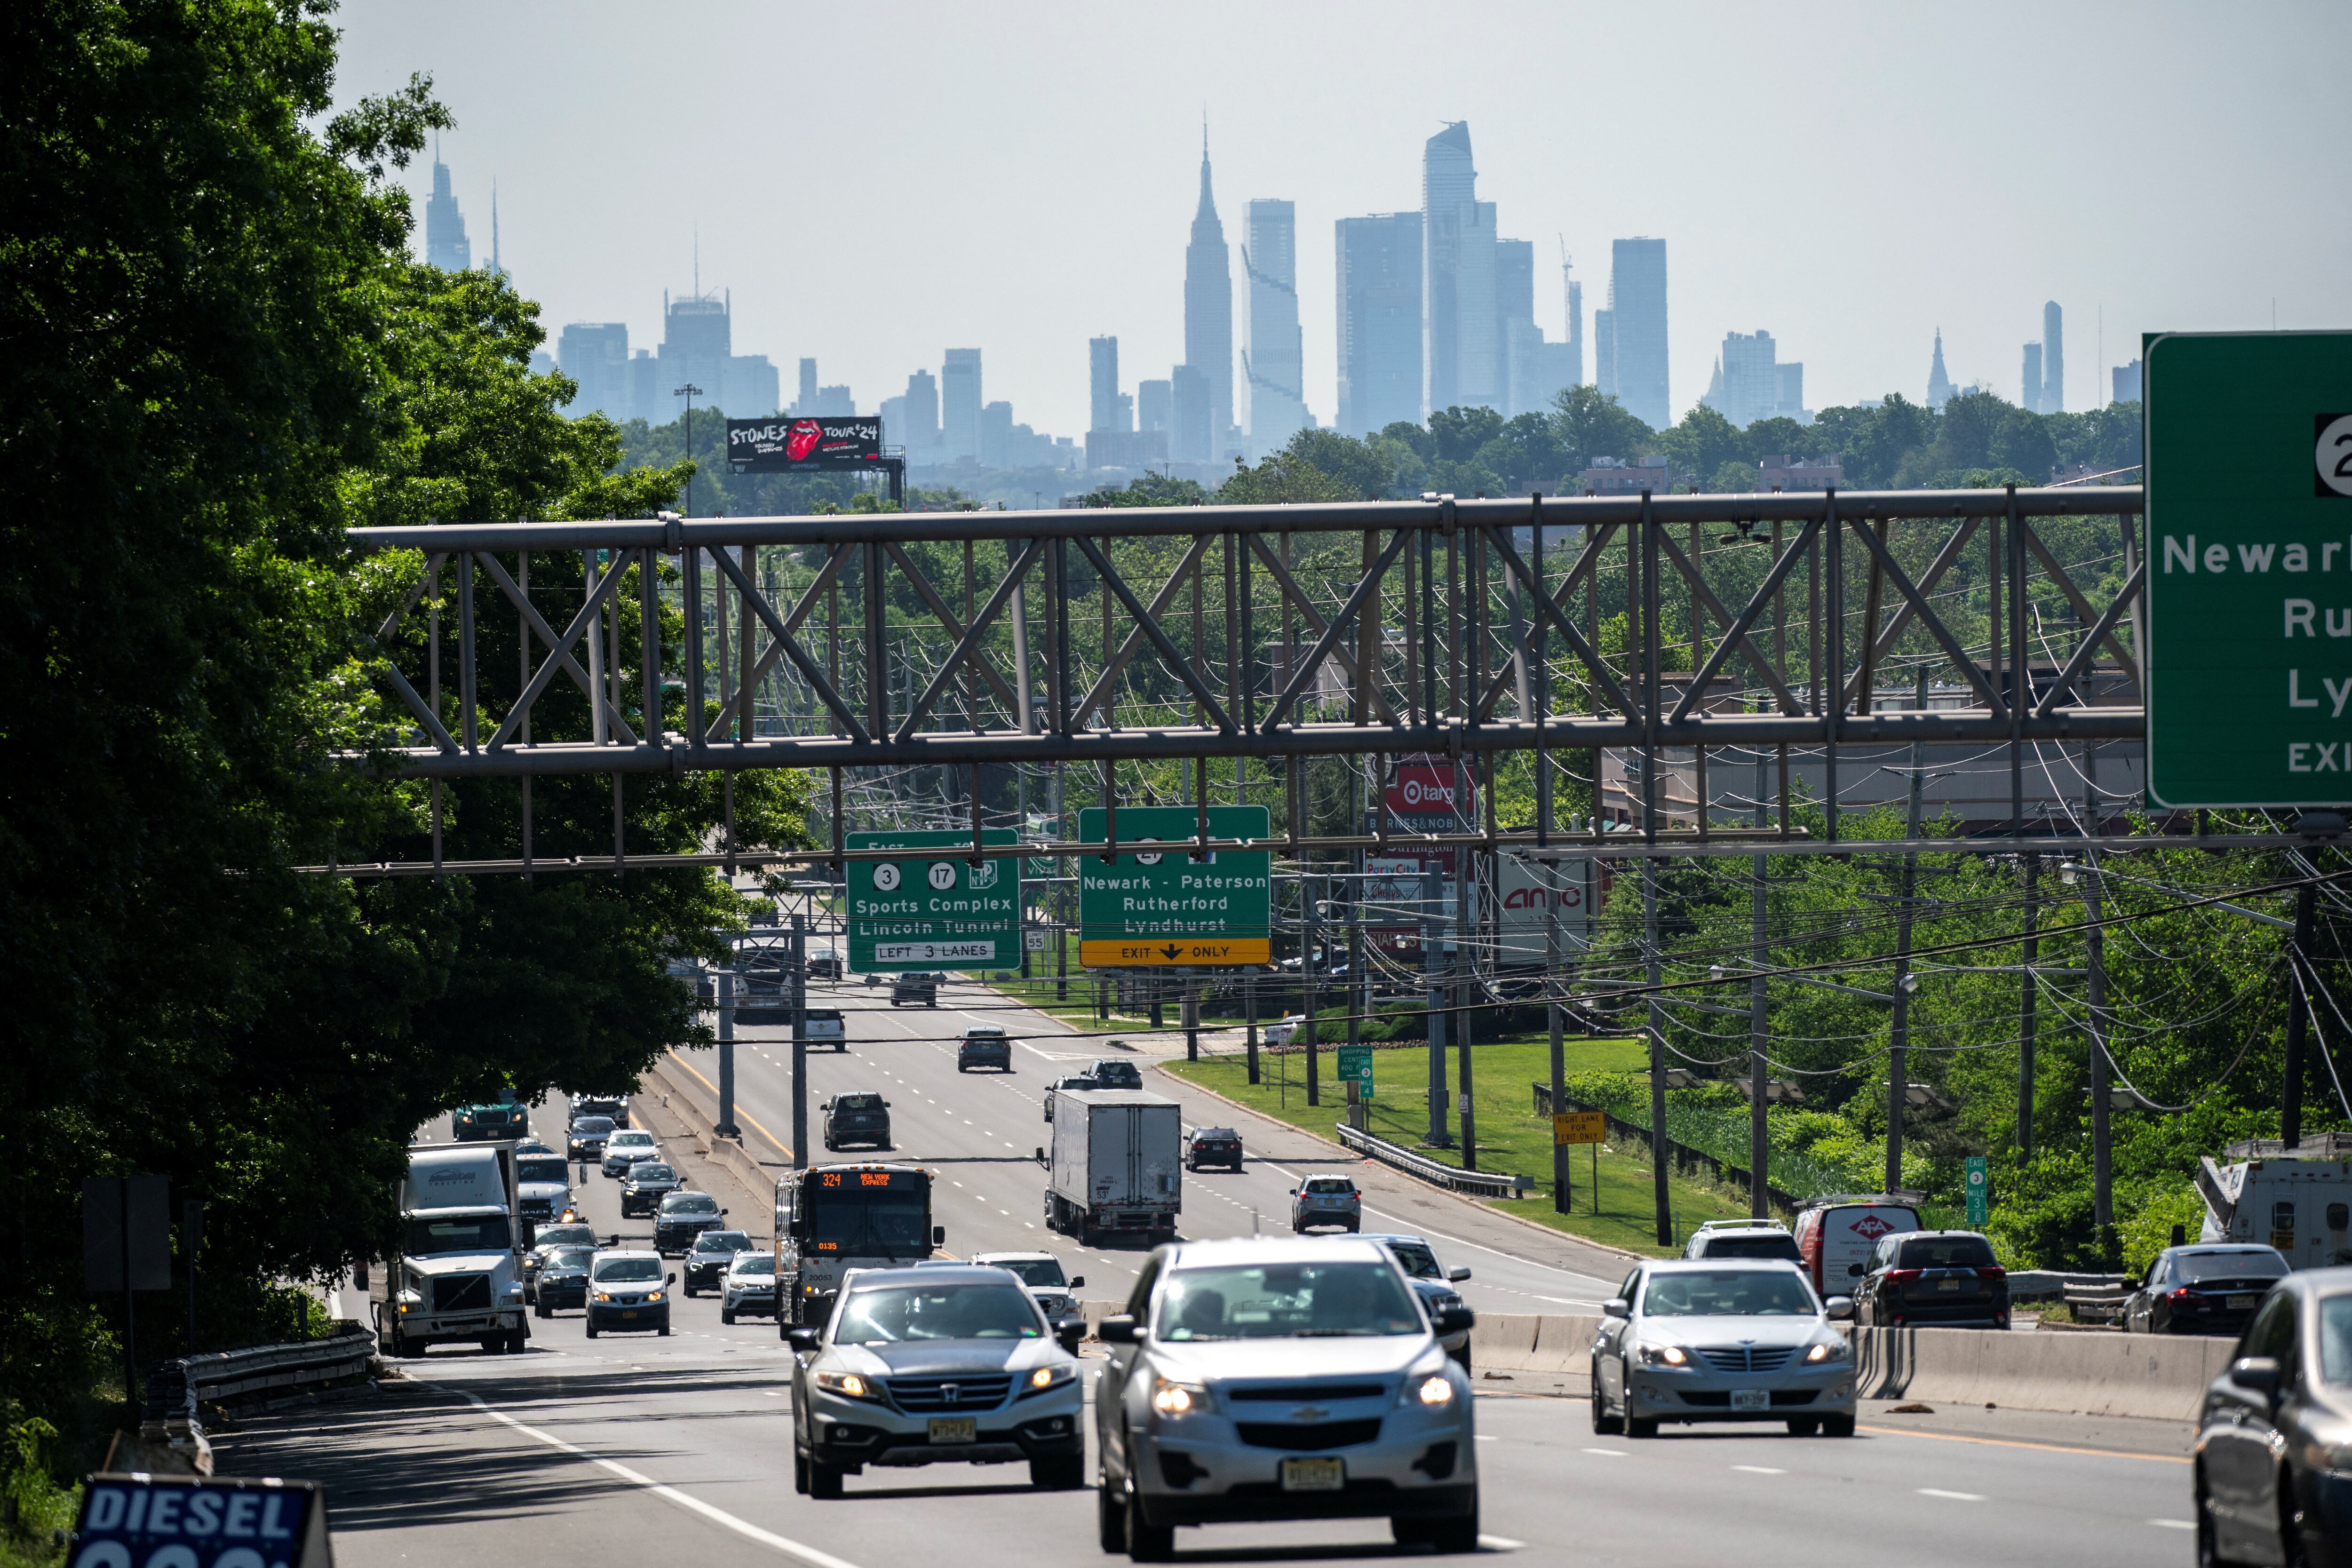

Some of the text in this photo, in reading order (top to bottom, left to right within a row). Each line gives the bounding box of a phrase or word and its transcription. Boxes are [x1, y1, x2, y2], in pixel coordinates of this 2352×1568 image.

[731, 425, 787, 445] STONES
[824, 426, 855, 438] TOUR
[2164, 534, 2352, 574] Newar
[2284, 598, 2352, 637] Ru
[2289, 669, 2352, 718] Ly
[2288, 742, 2352, 772] EXI
[1423, 784, 1470, 804] targt
[882, 869, 892, 884] 3
[935, 868, 950, 883] 17
[1084, 876, 1151, 890] Newark
[1181, 875, 1265, 889] Paterson
[856, 897, 1011, 916] Sports Complex
[1123, 896, 1228, 911] Rutherford
[860, 918, 1008, 935] Lincoln Tunnel
[1125, 918, 1226, 935] Lyndhurst
[1029, 938, 1042, 947] 55
[879, 945, 987, 958] LEFT 3 LANES
[1122, 946, 1230, 958] EXIT ONLY
[1969, 1159, 1983, 1167] EAST
[823, 1174, 841, 1186] 324
[1974, 1198, 1980, 1208] 3
[85, 1488, 290, 1538] DIESEL
